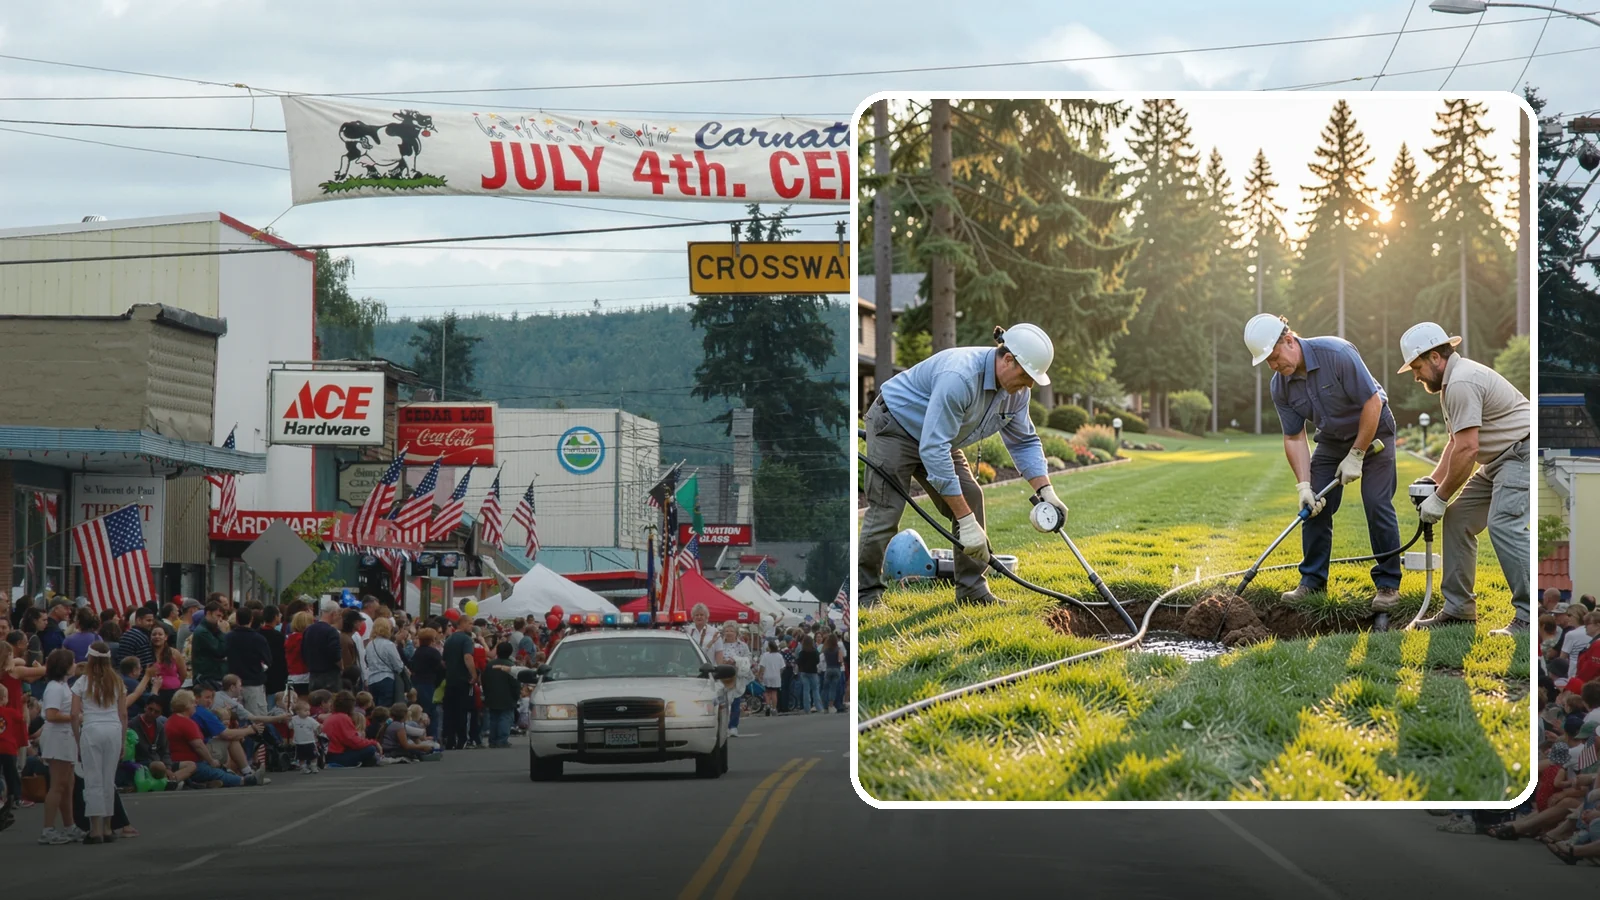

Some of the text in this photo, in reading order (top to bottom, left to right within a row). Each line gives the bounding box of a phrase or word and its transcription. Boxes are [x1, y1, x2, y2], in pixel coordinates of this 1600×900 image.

[481, 141, 604, 193] JULY
[632, 150, 746, 198] 4th.
[696, 254, 850, 280] CROSSWA
[283, 380, 373, 420] ACE
[405, 408, 452, 422] CEDAR
[284, 421, 371, 437] Hardware
[416, 428, 477, 447] Coca-Cola
[353, 467, 385, 479] Simpl
[96, 485, 124, 494] Vincent
[126, 486, 135, 495] de
[137, 486, 155, 495] Paul
[688, 526, 741, 535] CRNATION
[699, 535, 730, 543] GLASS
